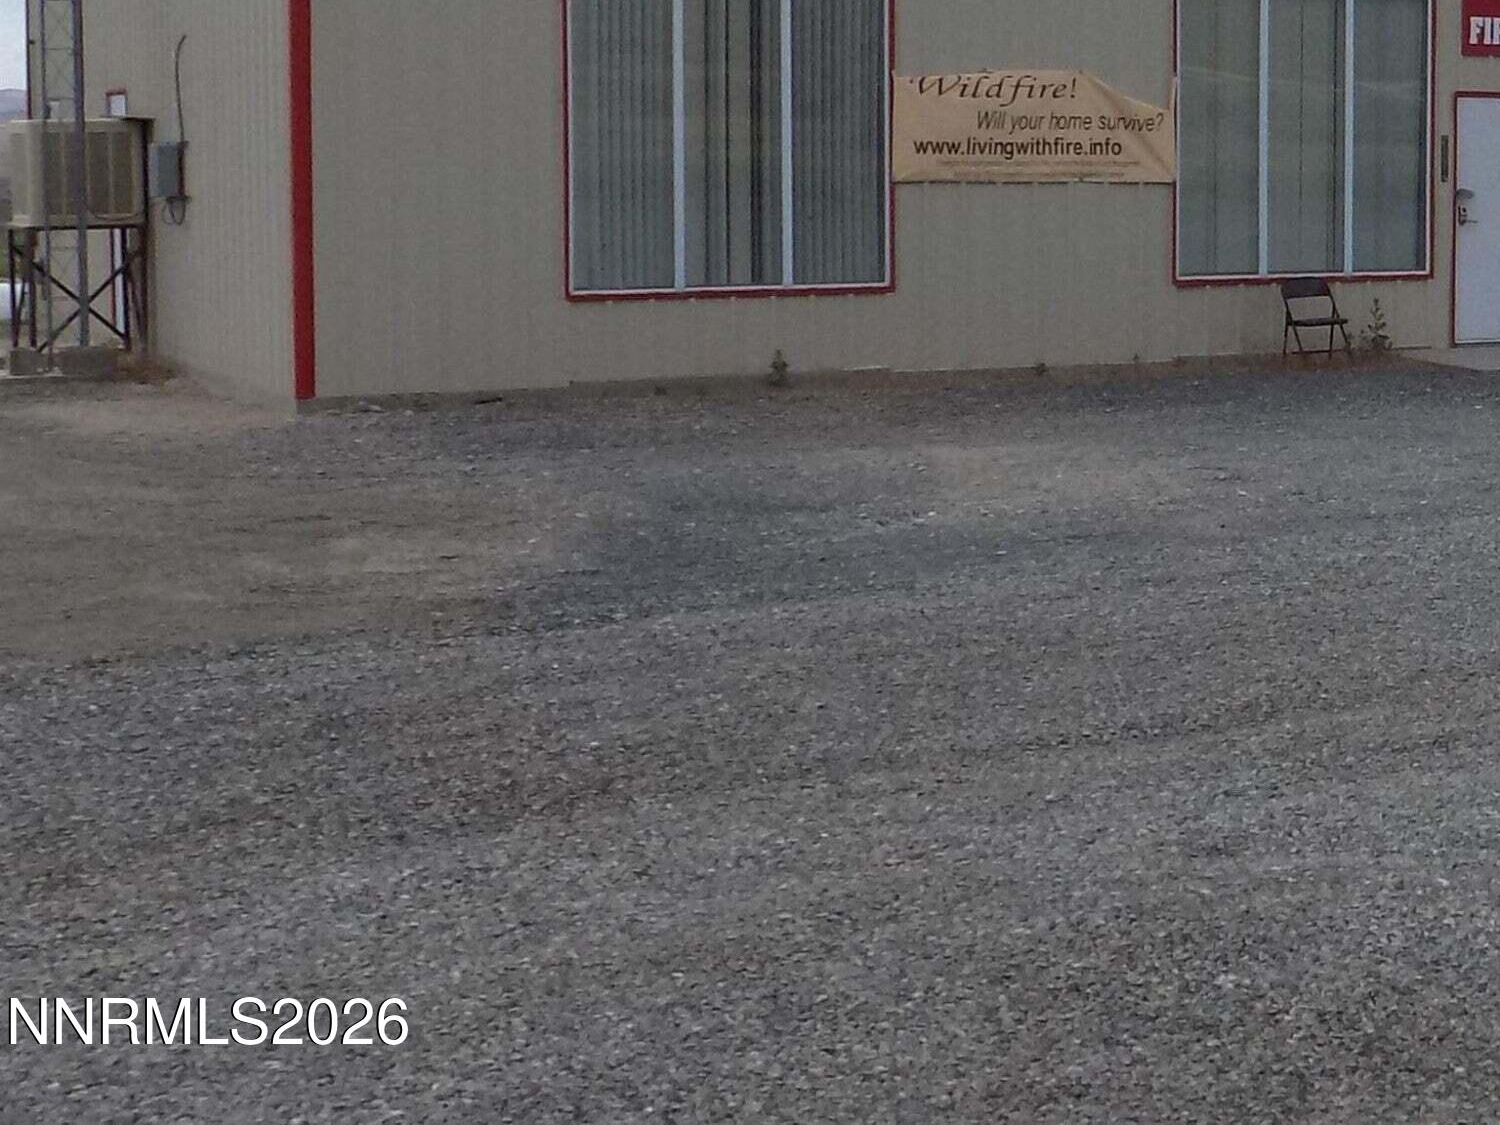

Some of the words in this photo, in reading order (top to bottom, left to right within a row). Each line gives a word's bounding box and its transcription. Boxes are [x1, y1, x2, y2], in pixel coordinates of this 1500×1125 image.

[909, 75, 1077, 107] Wildfire!
[977, 111, 1005, 130] Will
[1008, 115, 1044, 135] your
[1049, 112, 1092, 131] home
[1098, 112, 1164, 132] survive?
[913, 137, 1122, 160] www.livingwithfire.info
